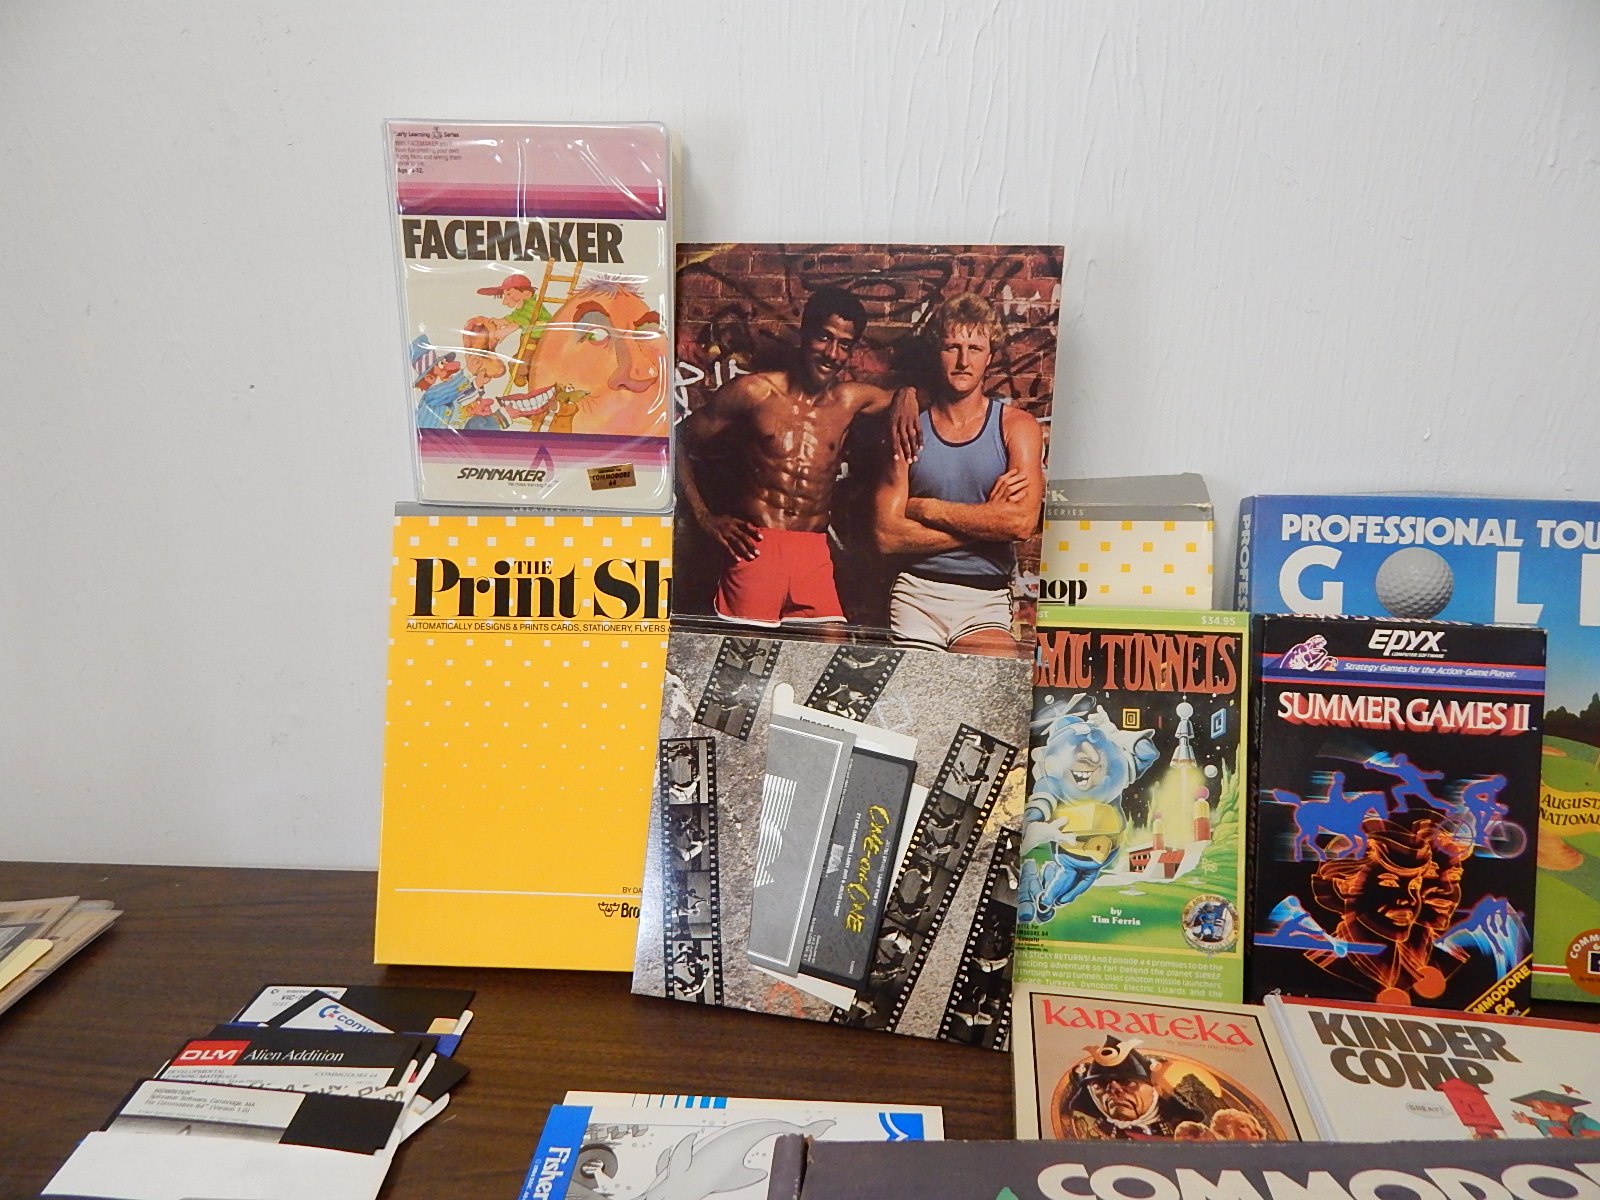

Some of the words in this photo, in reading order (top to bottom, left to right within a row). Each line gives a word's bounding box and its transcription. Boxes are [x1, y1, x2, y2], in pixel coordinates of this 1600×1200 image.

[402, 219, 624, 264] FACEMAKER
[457, 467, 546, 482] SPINNAKER
[1281, 514, 1525, 547] PROFESSIONAL
[513, 560, 553, 575] THE
[1238, 514, 1251, 611] PROFES
[407, 558, 583, 618] Print
[406, 622, 473, 631] AUTOMATICALLY
[474, 623, 511, 631] DESIGNS
[520, 624, 549, 632] PRINTS
[551, 624, 582, 633] CARDS,
[583, 625, 633, 633] STATIONERY,
[1201, 616, 1236, 626] $34.95
[1100, 632, 1237, 694] TUNNELS
[1344, 662, 1379, 672] Strategy
[1380, 664, 1407, 672] Games
[1408, 666, 1420, 674] for
[1435, 667, 1489, 676] Action-Game
[1277, 692, 1406, 729] SUMMER
[1405, 698, 1507, 732] GAMES
[1541, 794, 1600, 809] AUGUST
[1110, 907, 1123, 917] by
[1091, 915, 1112, 925] Tim
[1113, 916, 1141, 926] Ferris
[1051, 962, 1090, 970] adventure
[1120, 966, 1148, 974] Defend
[1152, 960, 1187, 968] promises
[1052, 971, 1071, 979] warp
[1125, 976, 1153, 984] photon
[1124, 984, 1153, 992] Electric
[1158, 987, 1185, 995] Lizards
[1190, 989, 1205, 997] and
[1495, 997, 1515, 1016] 64
[1308, 1011, 1522, 1063] KINDER
[180, 1050, 239, 1060] DLM
[244, 1049, 282, 1060] Alien
[282, 1050, 344, 1062] Addition
[1330, 1047, 1494, 1095] COMP
